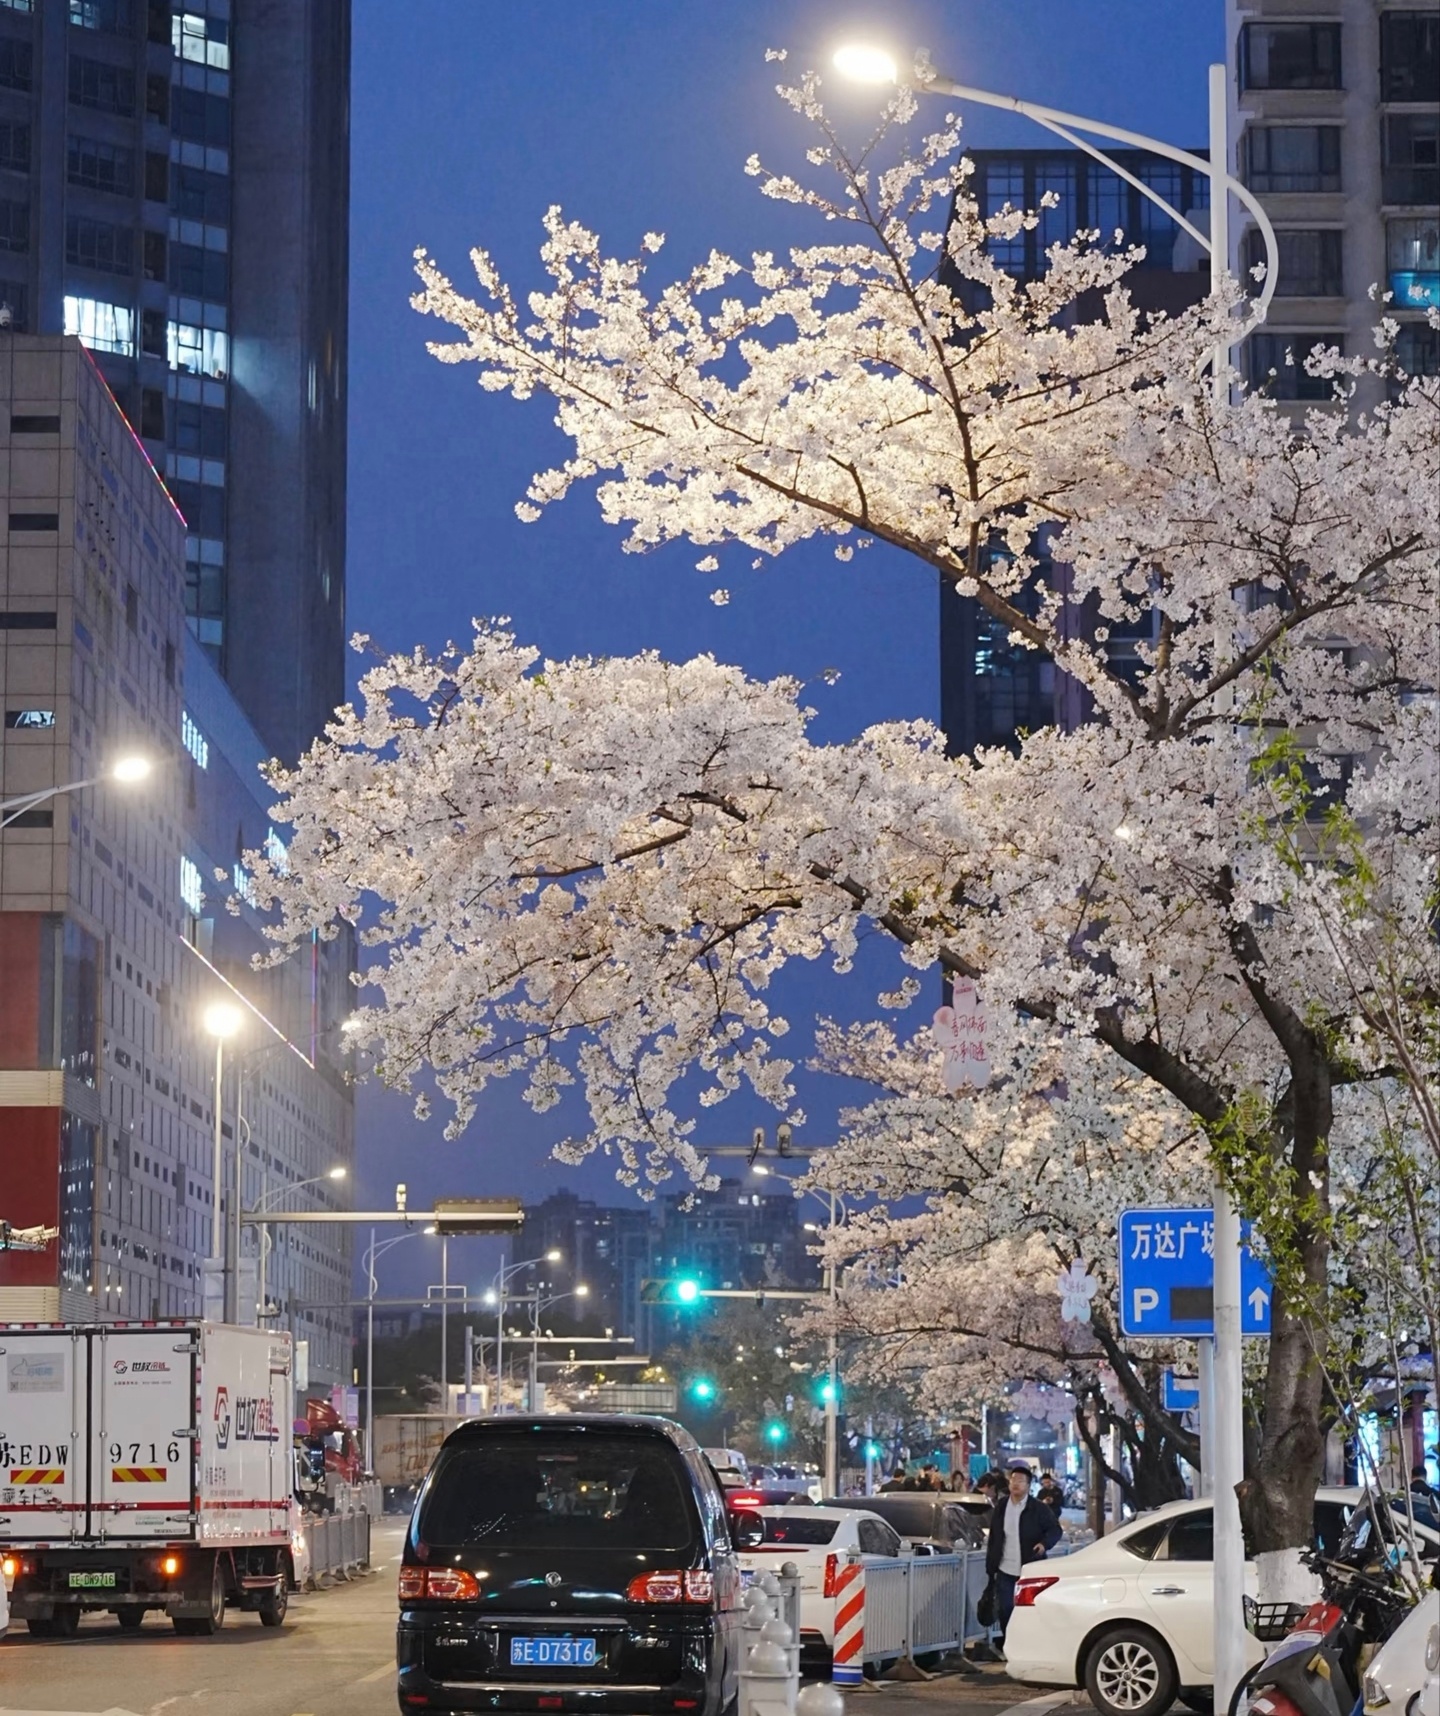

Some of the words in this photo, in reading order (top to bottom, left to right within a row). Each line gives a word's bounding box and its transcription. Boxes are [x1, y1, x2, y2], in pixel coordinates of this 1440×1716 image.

[1133, 1288, 1159, 1322] P
[0, 1442, 69, 1468] 苏EDW
[110, 1442, 180, 1464] 9716
